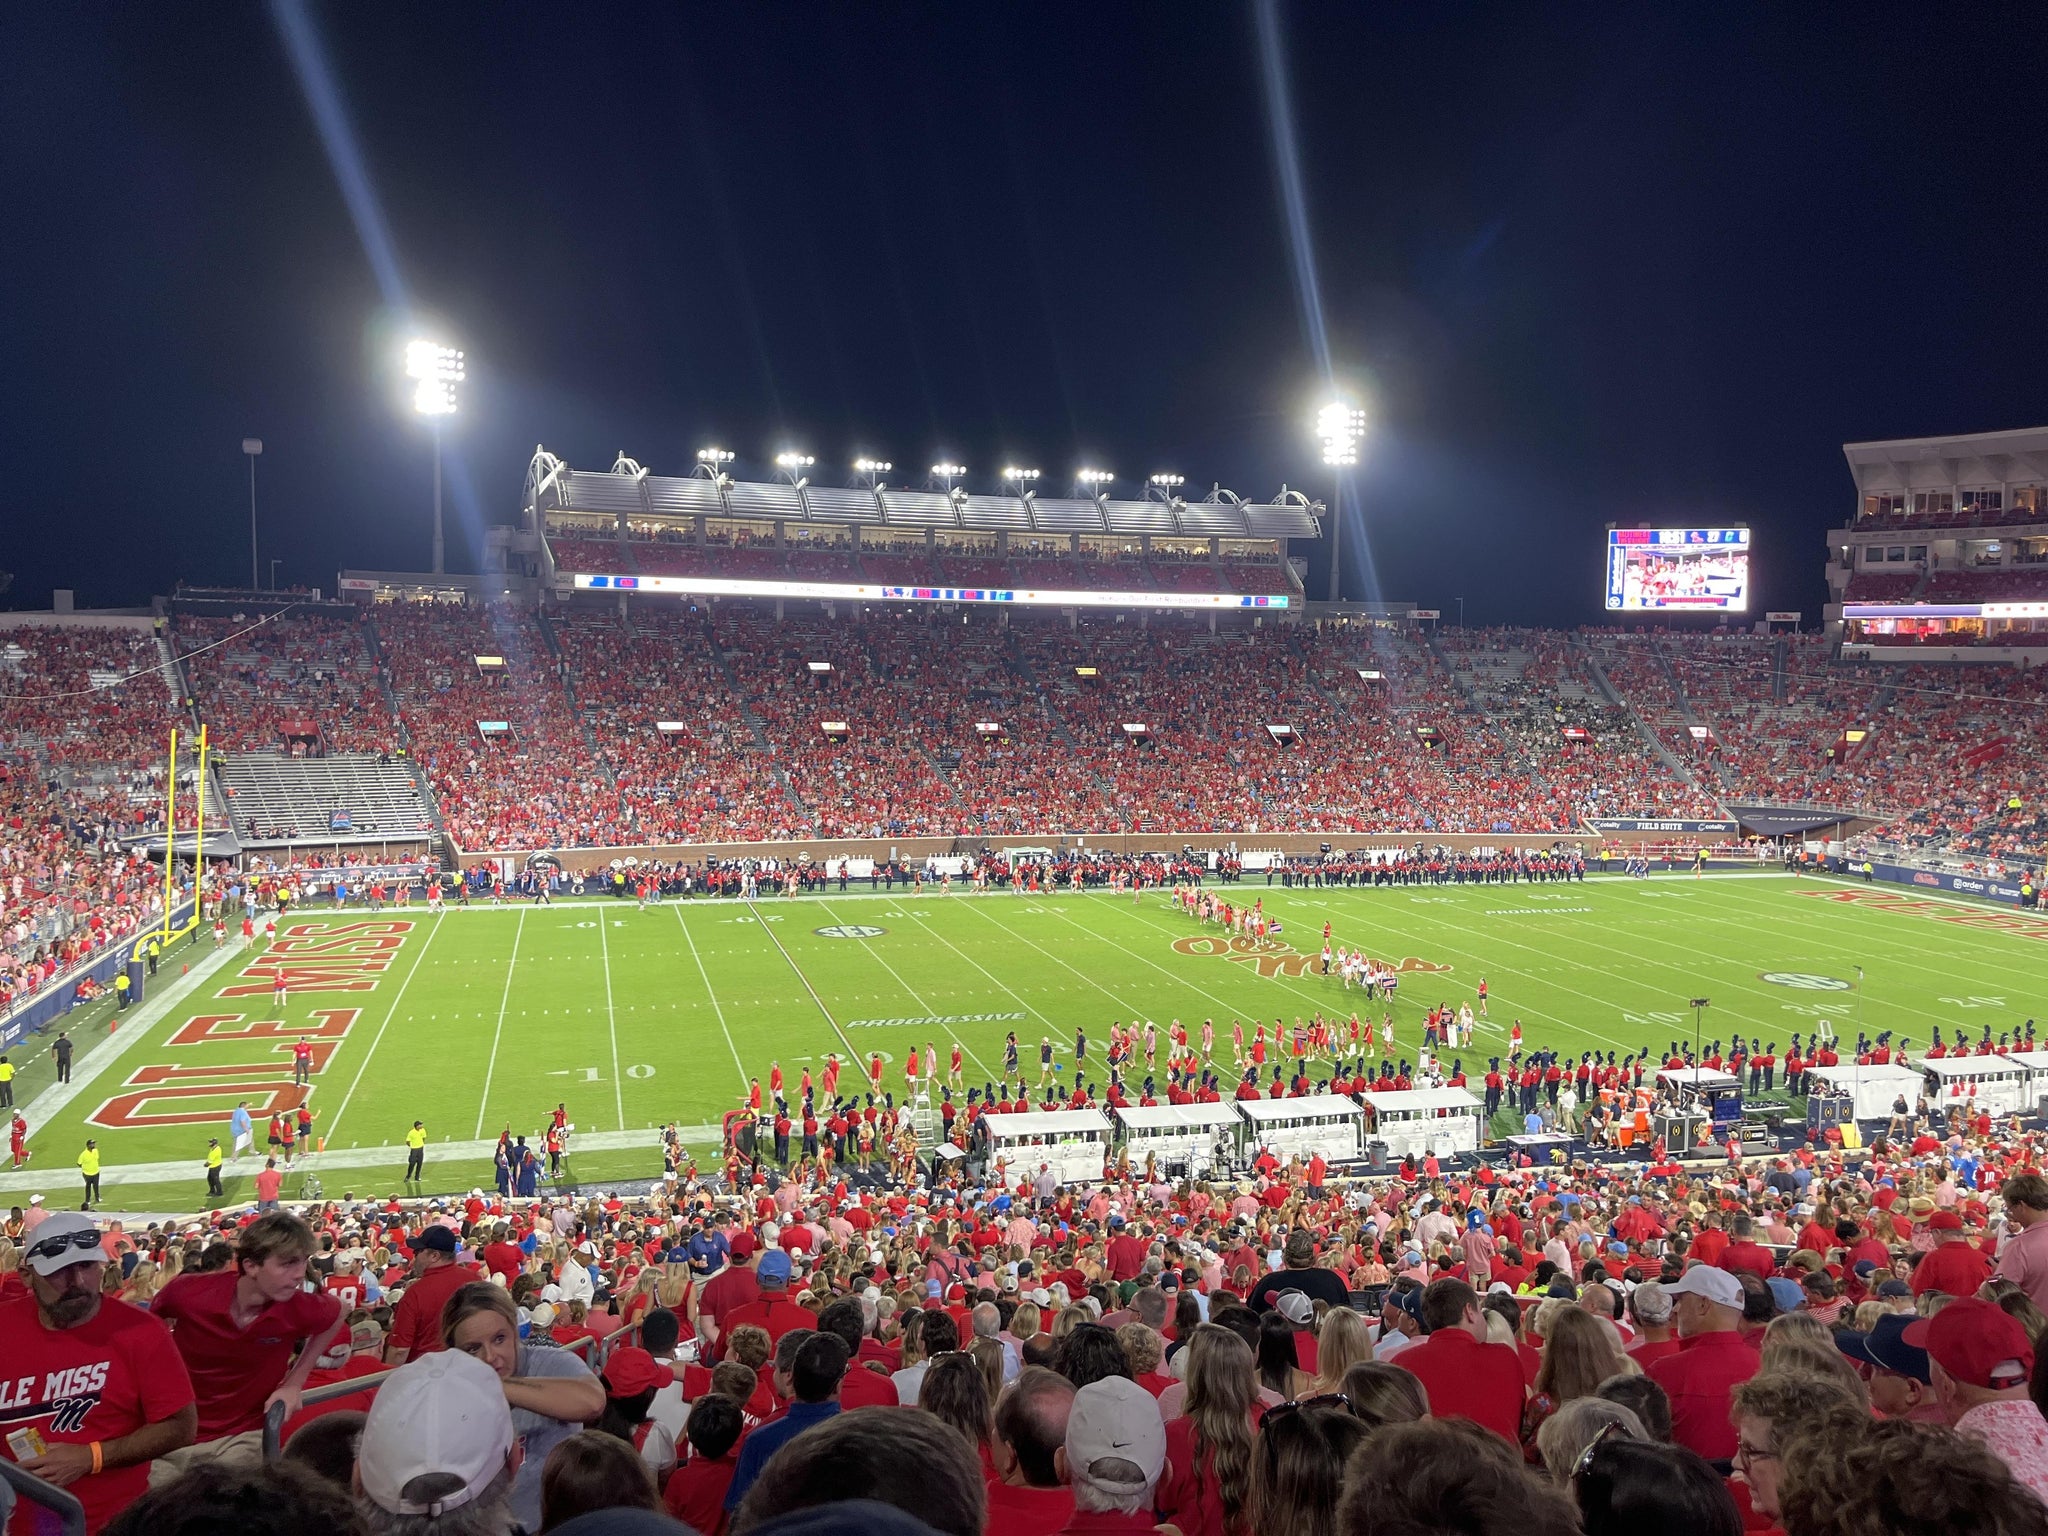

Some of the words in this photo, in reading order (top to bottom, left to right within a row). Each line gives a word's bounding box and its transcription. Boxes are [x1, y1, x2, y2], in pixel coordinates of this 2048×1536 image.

[1600, 821, 1620, 829] cotality
[1637, 822, 1659, 830] FIELD
[1660, 823, 1682, 831] SUITE
[1705, 823, 1726, 831] cotality
[1962, 880, 1984, 890] arden
[1485, 907, 1593, 915] PROGRESSIVE
[817, 925, 884, 938] SEC
[214, 920, 417, 999] MISS
[846, 1012, 1027, 1028] PROGRESSIVE
[84, 1007, 363, 1129] OLE
[576, 1063, 656, 1082] 10
[0, 1376, 36, 1410] LE
[42, 1361, 111, 1402] MISS
